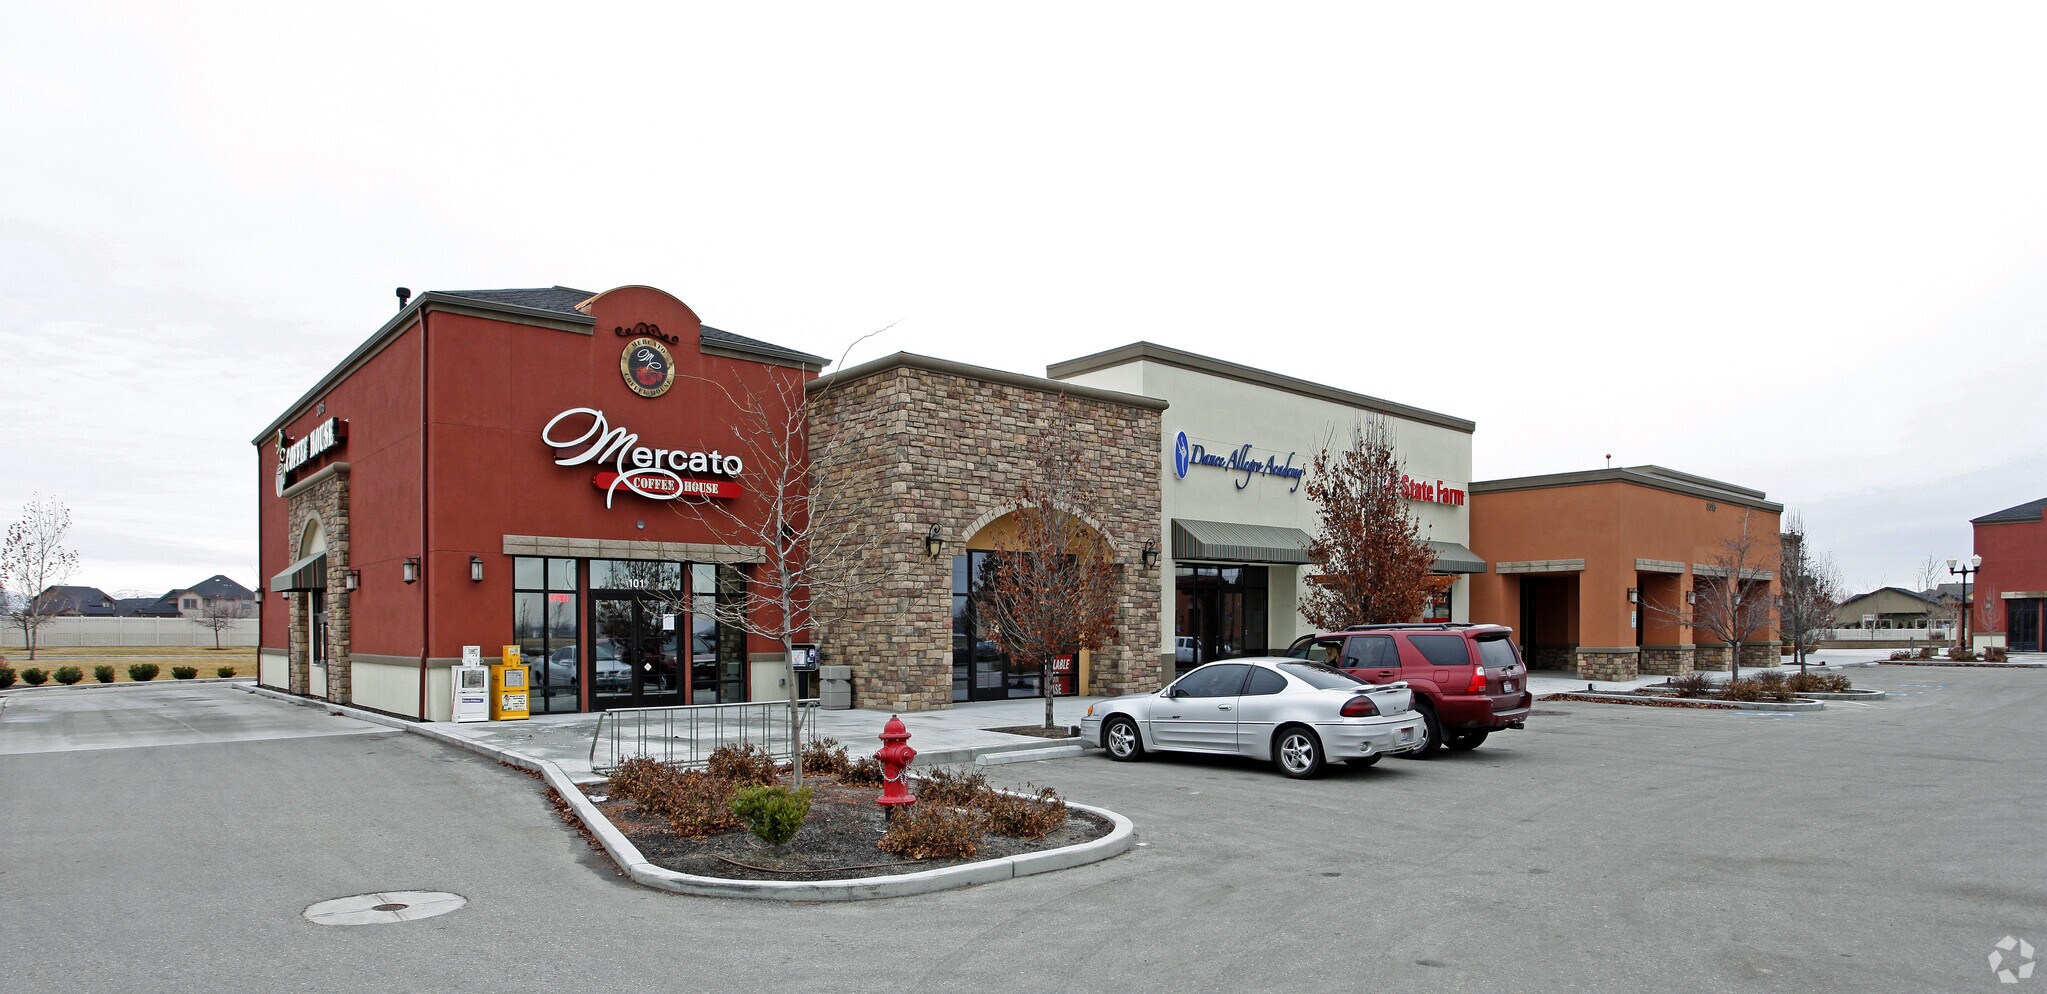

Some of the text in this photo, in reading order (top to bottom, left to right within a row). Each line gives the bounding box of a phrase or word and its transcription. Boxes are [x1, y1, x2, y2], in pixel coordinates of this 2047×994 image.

[631, 338, 666, 354] MERCATO
[624, 372, 672, 396] COFFEE HOUSE
[541, 407, 744, 510] Mercato
[1189, 443, 1303, 493] Dance Allegro Academy
[633, 476, 719, 495] COFFEE HOUSE
[1401, 474, 1466, 506] State Farm
[628, 578, 645, 589] 101
